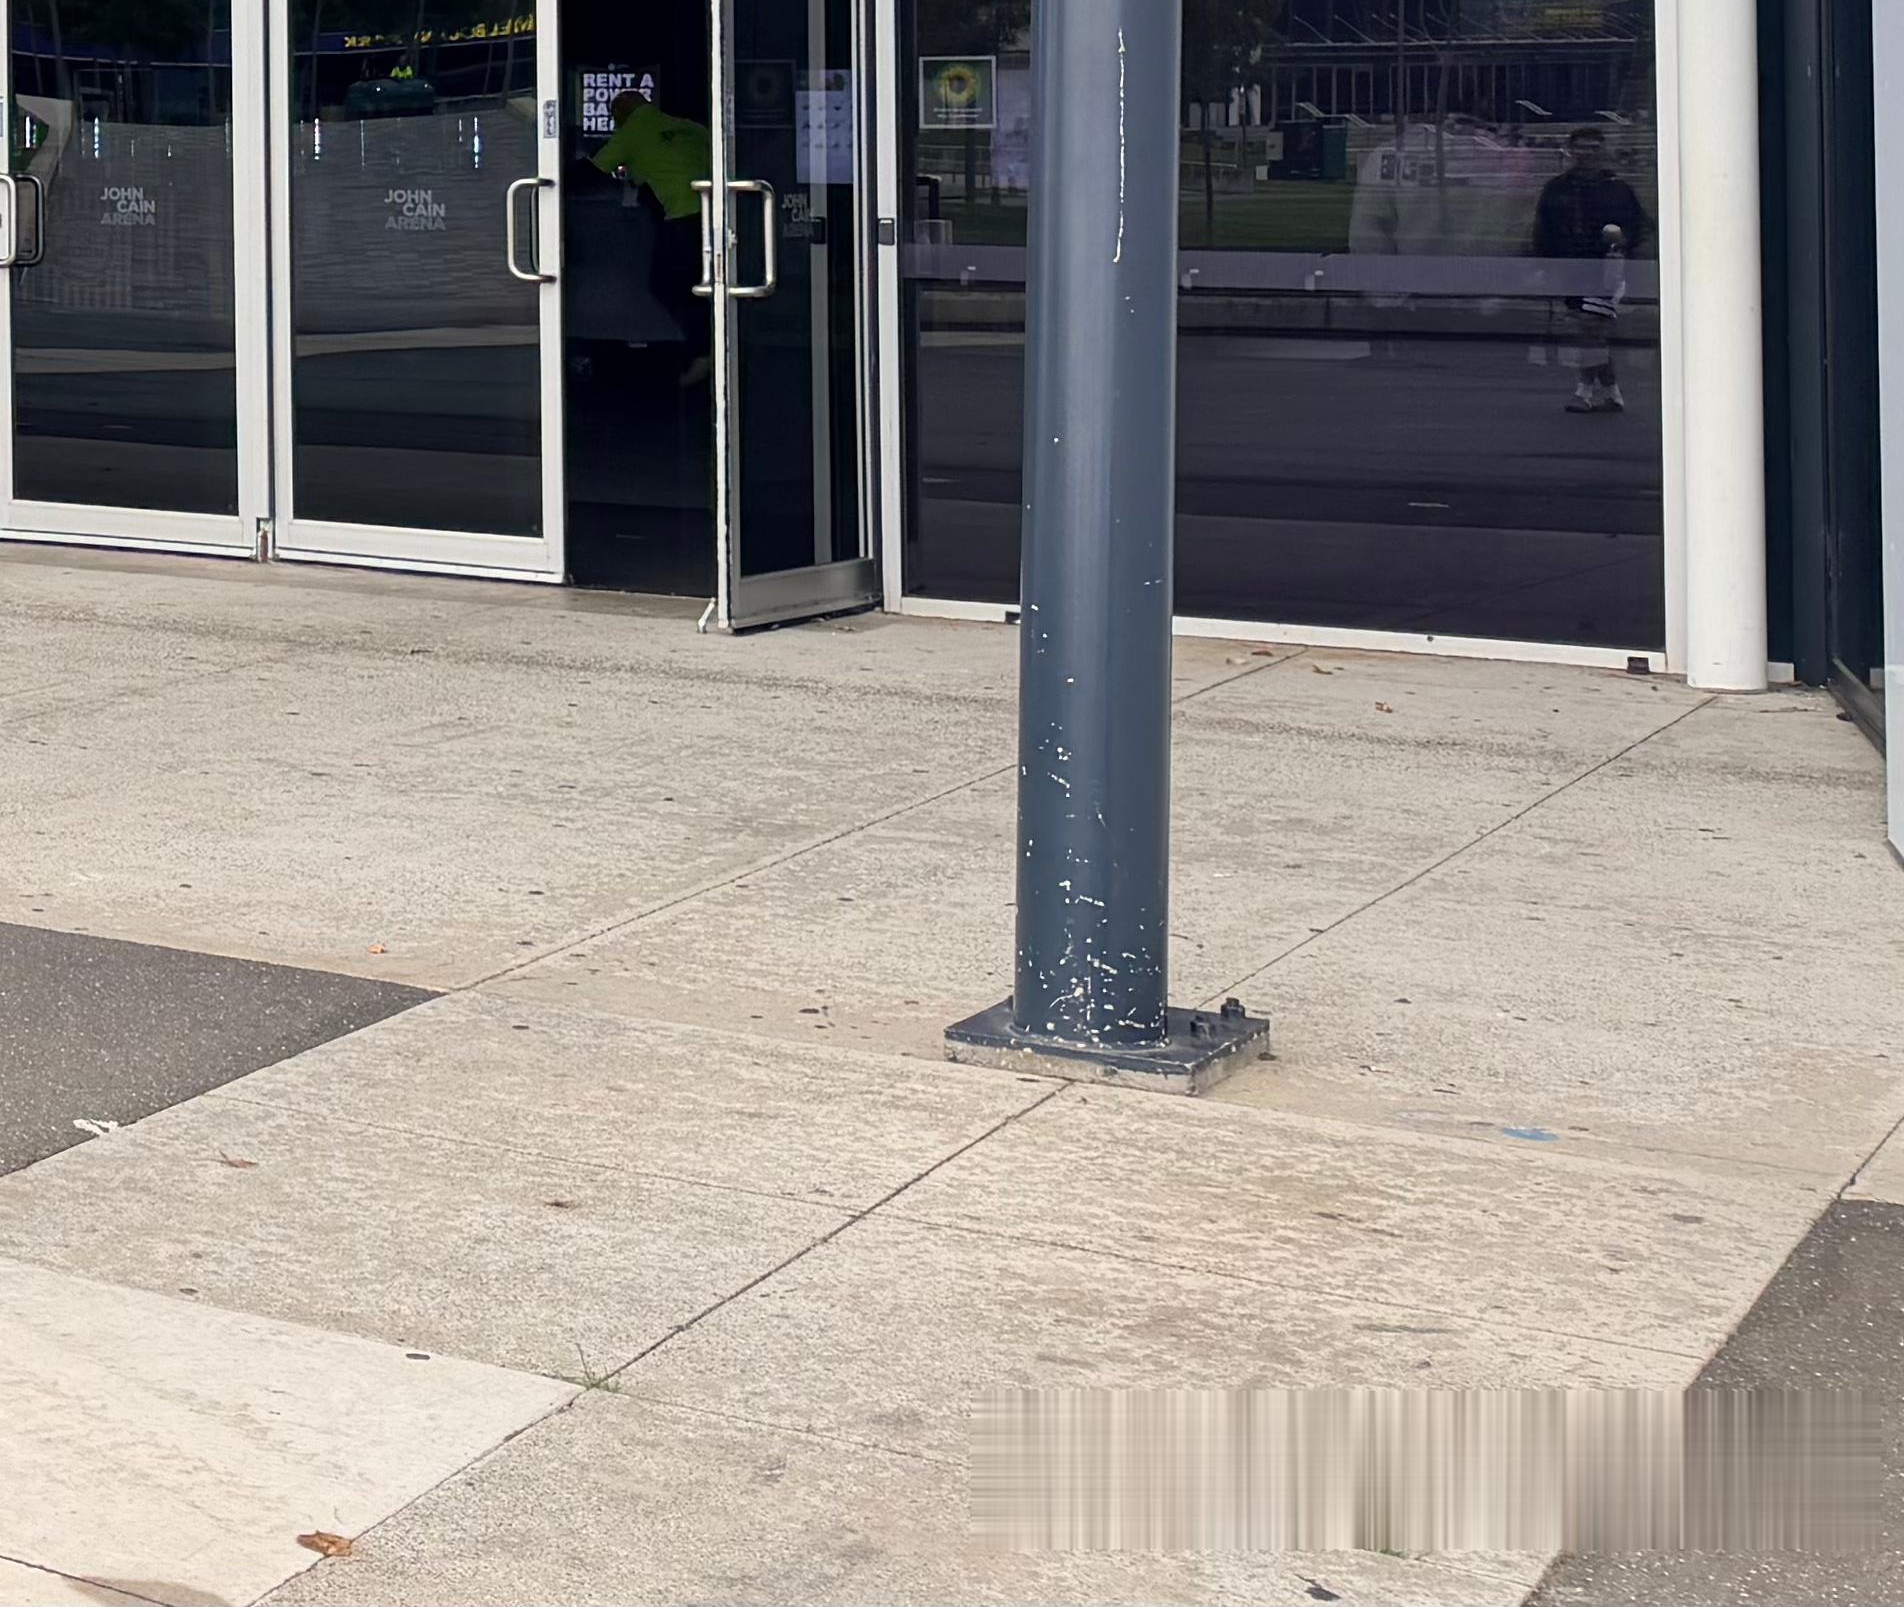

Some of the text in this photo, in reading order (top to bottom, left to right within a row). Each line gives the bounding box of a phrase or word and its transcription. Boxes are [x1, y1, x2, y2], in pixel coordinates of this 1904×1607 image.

[583, 73, 654, 87] RENT A
[100, 187, 143, 200] JOHN
[384, 190, 431, 203] JOHN
[117, 200, 155, 213] CAIN
[403, 203, 445, 216] CAIN
[100, 213, 155, 225] ARENA
[385, 216, 446, 230] ARENA
